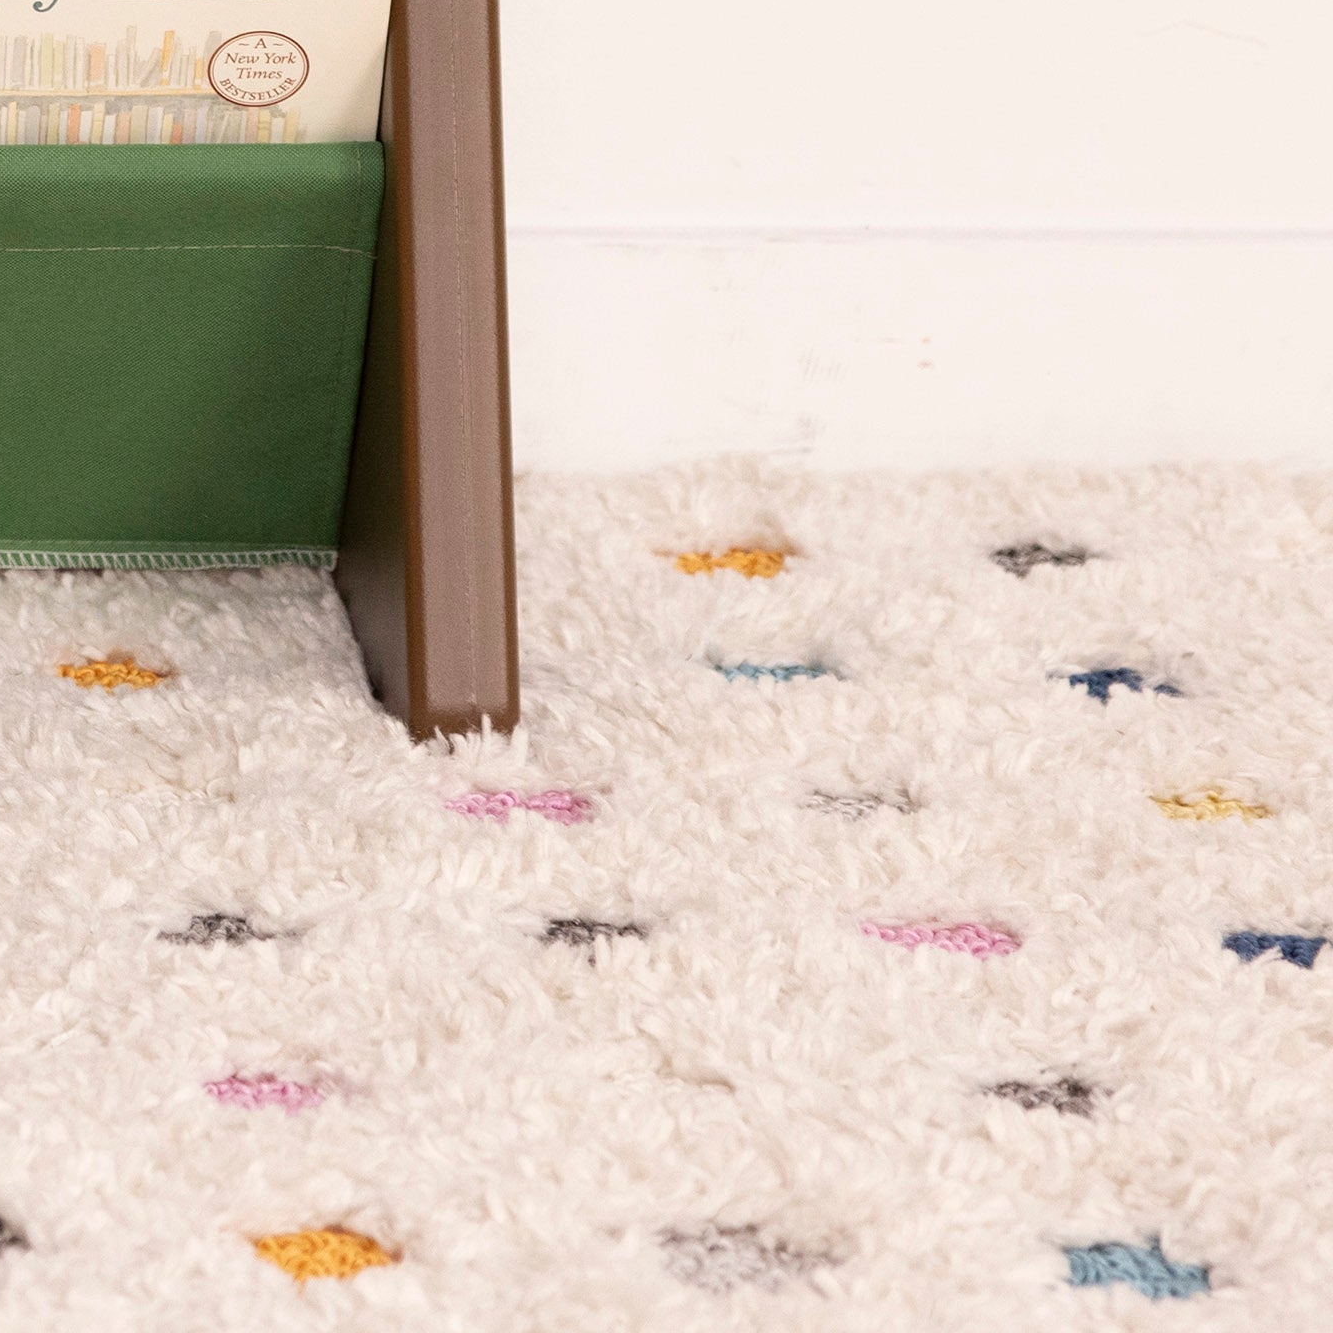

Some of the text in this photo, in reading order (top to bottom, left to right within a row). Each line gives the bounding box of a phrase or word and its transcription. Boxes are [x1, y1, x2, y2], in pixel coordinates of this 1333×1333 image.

[254, 37, 267, 49] A
[224, 52, 297, 65] New York
[236, 67, 283, 80] Times
[219, 76, 297, 101] BESTSELLER
